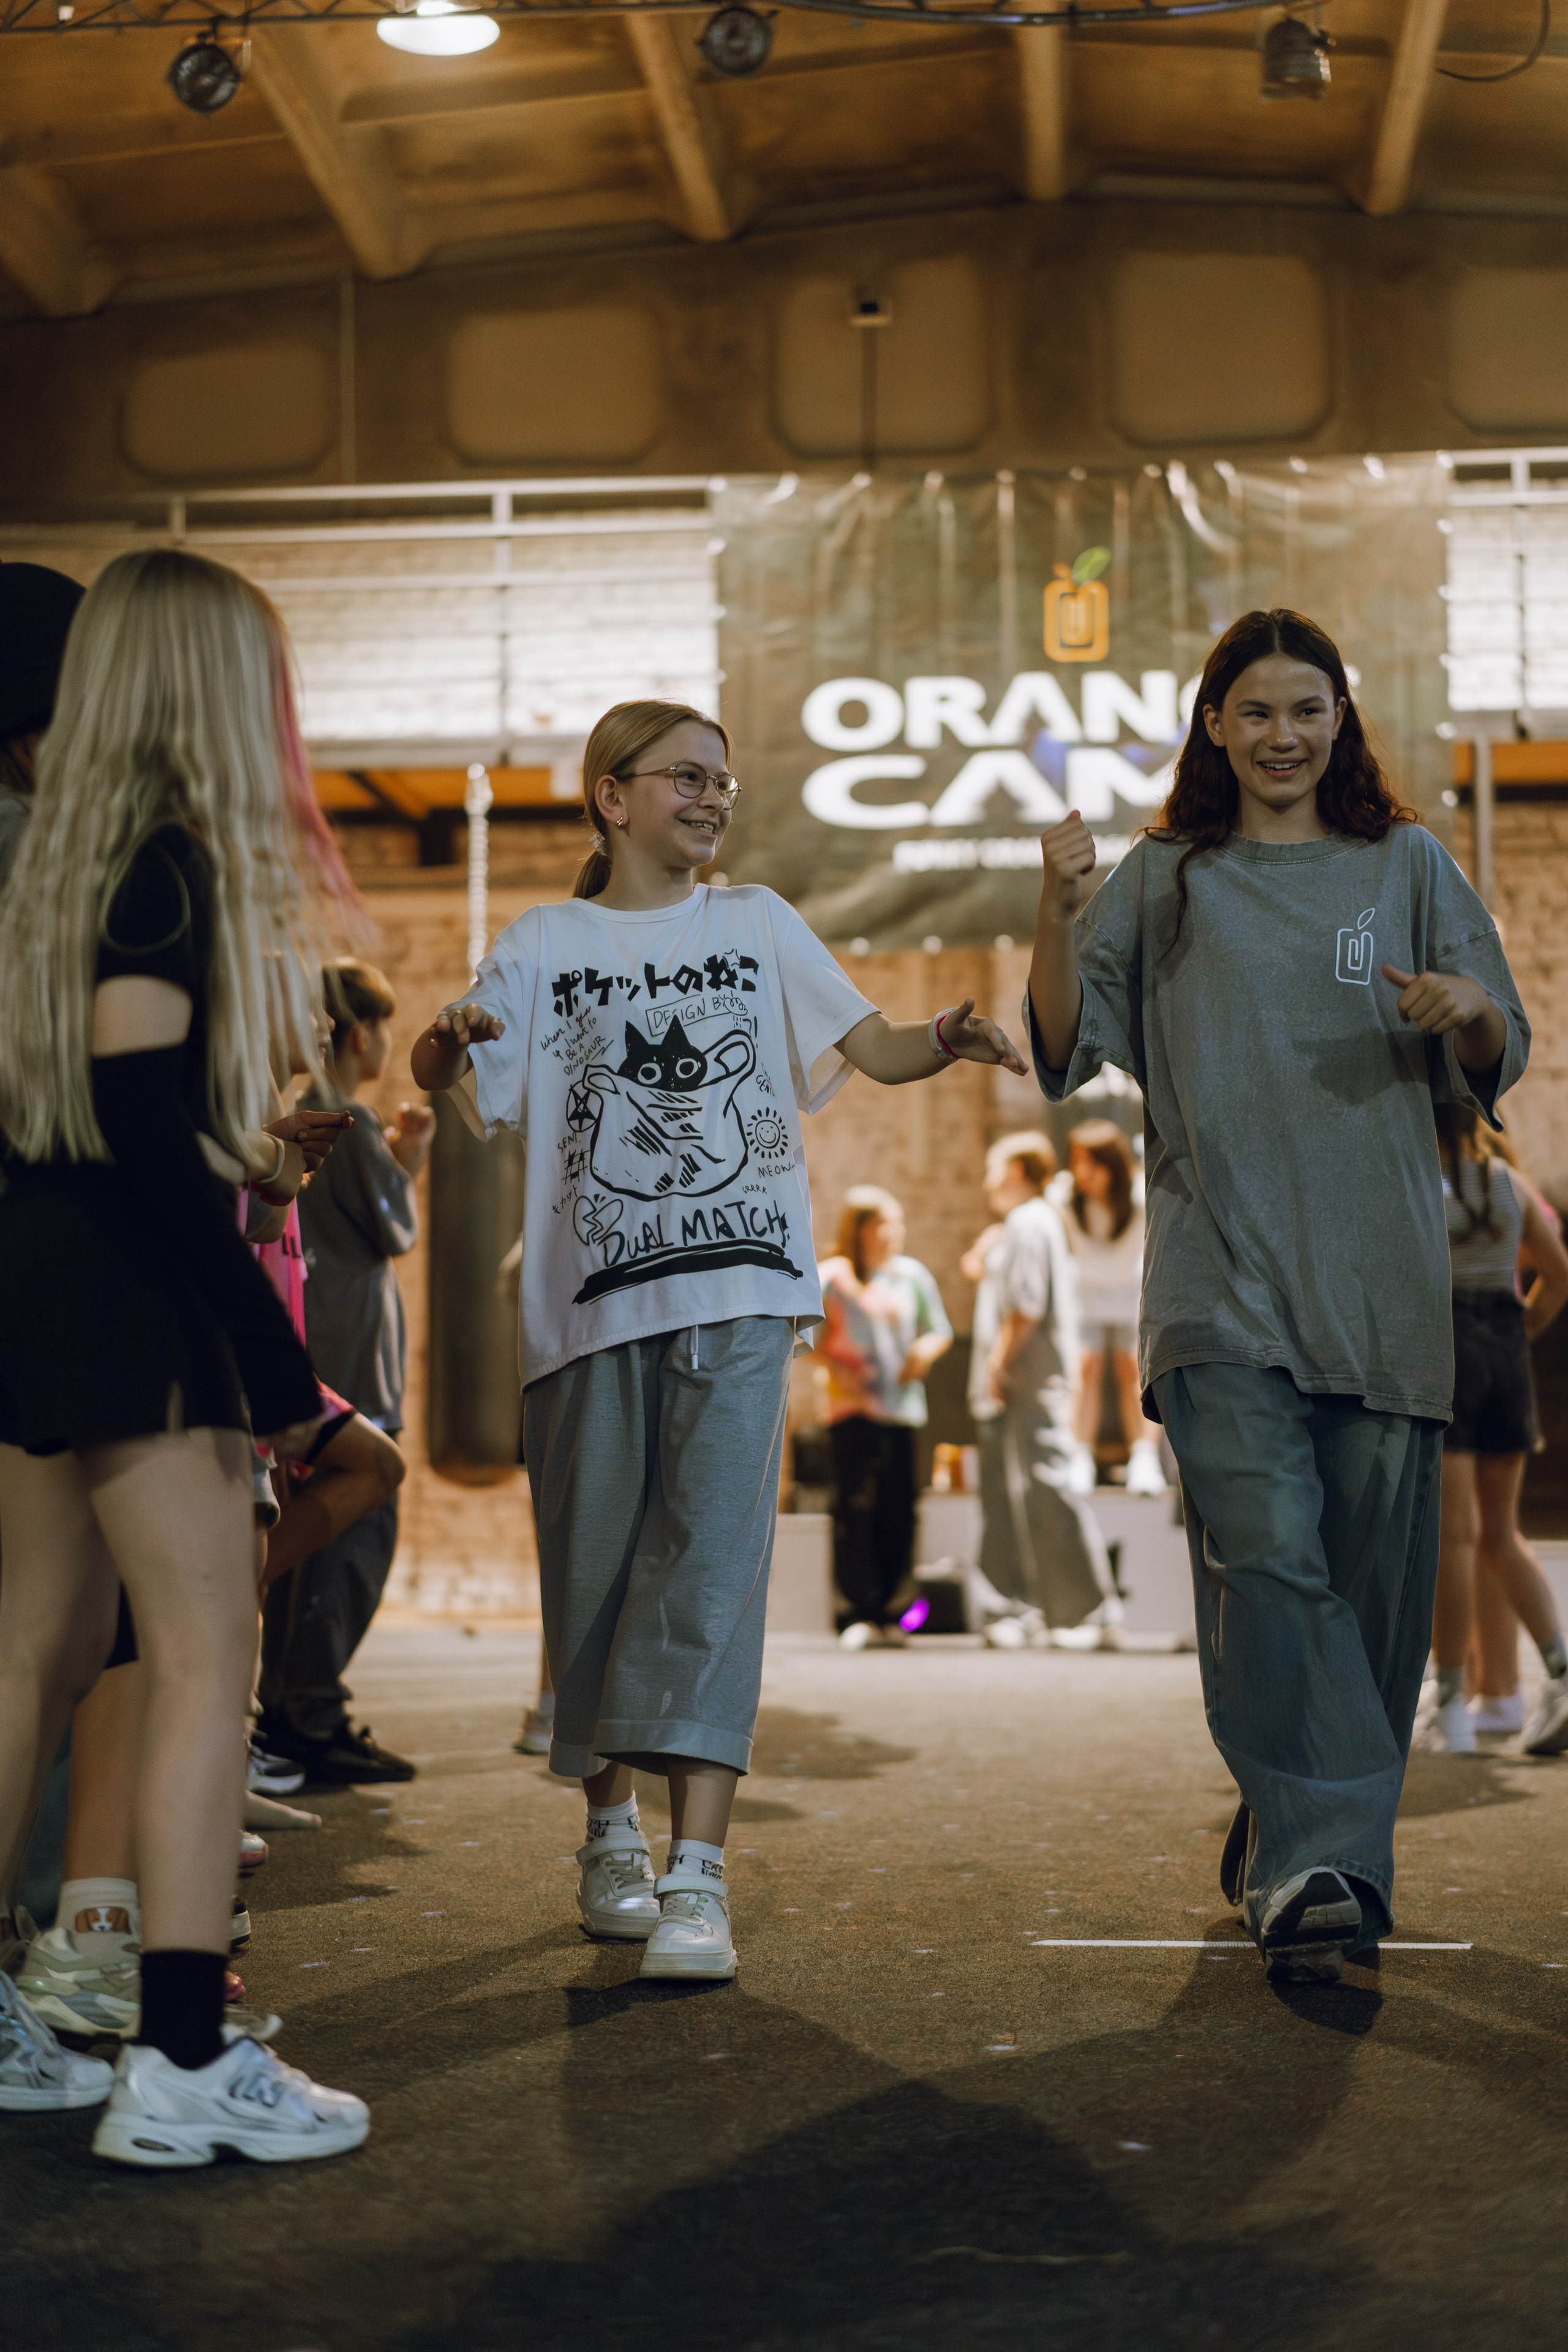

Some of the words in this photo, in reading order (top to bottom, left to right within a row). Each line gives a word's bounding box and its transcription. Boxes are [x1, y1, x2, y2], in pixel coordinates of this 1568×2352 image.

[800, 669, 1204, 753] ORAN
[800, 747, 1177, 831] CAM
[654, 998, 706, 1029] DEIGN
[564, 1036, 606, 1076] DINOSAUR
